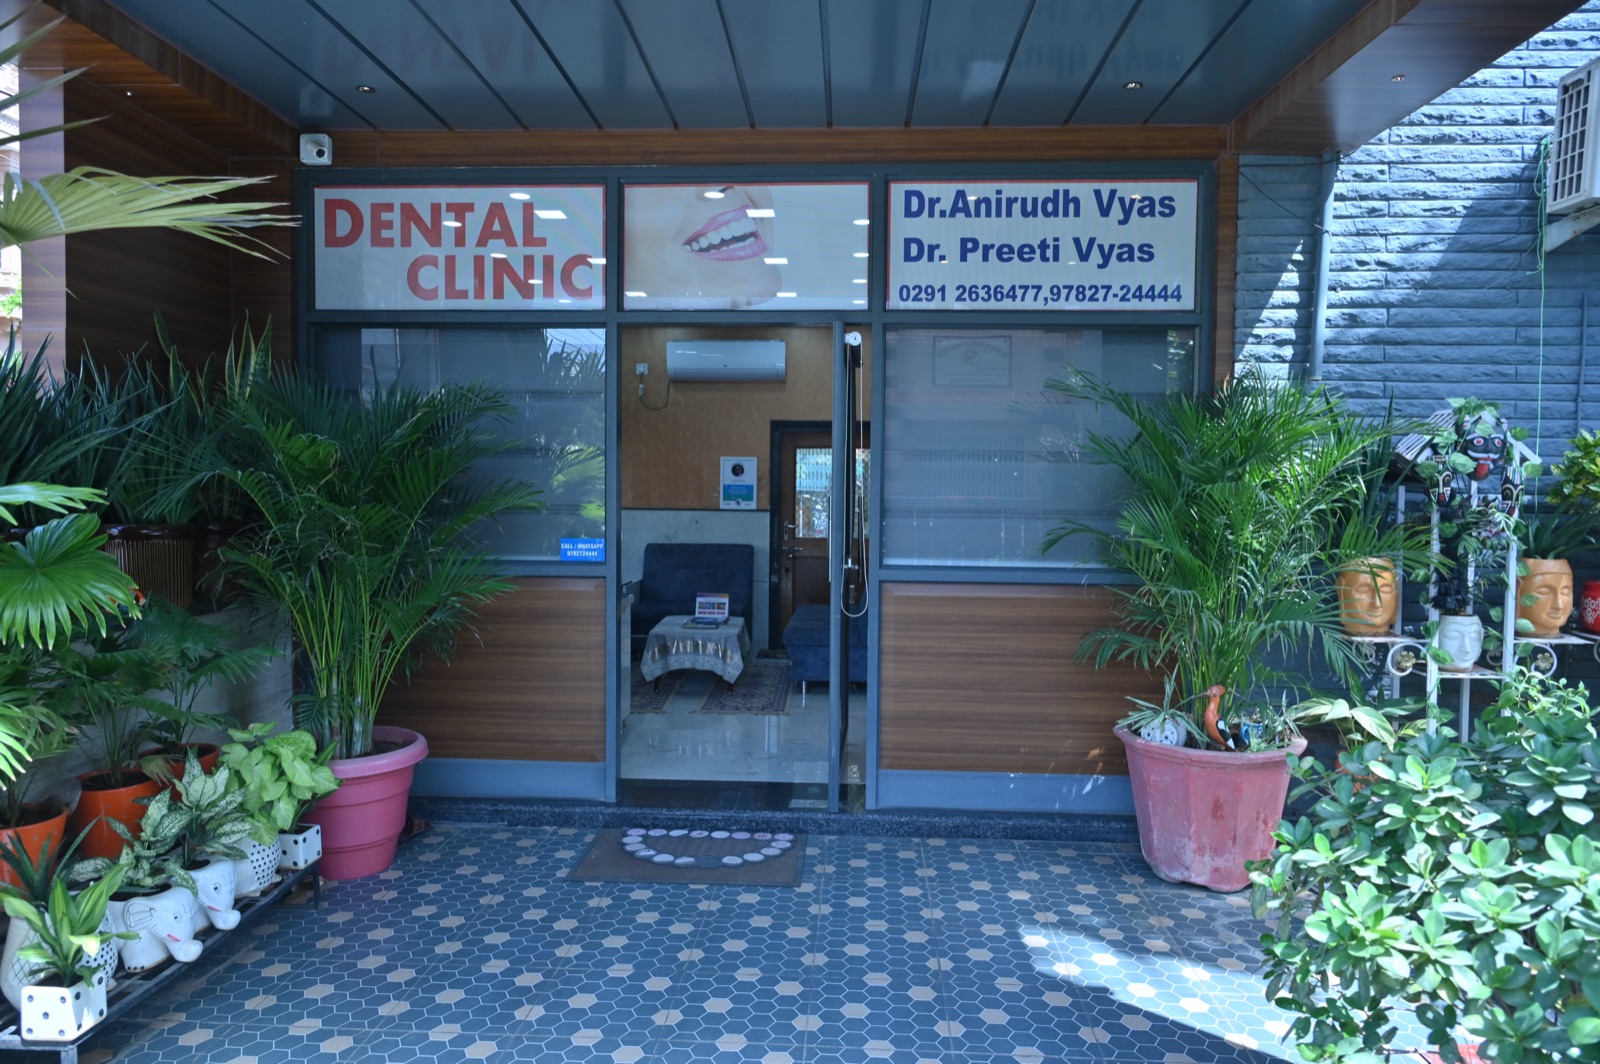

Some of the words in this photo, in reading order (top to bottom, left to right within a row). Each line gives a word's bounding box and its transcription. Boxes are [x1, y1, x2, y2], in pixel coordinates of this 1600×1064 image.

[324, 198, 547, 248] DENTAL
[903, 189, 1081, 218] Dr.Anirudh
[1093, 189, 1176, 226] Vyas
[903, 237, 947, 263] Dr.
[959, 237, 1060, 263] Preeti
[1072, 237, 1155, 269] Vyas
[406, 254, 593, 301] CLINIC
[898, 285, 947, 302] 0291
[955, 284, 1182, 306] 2636477,97827-24444
